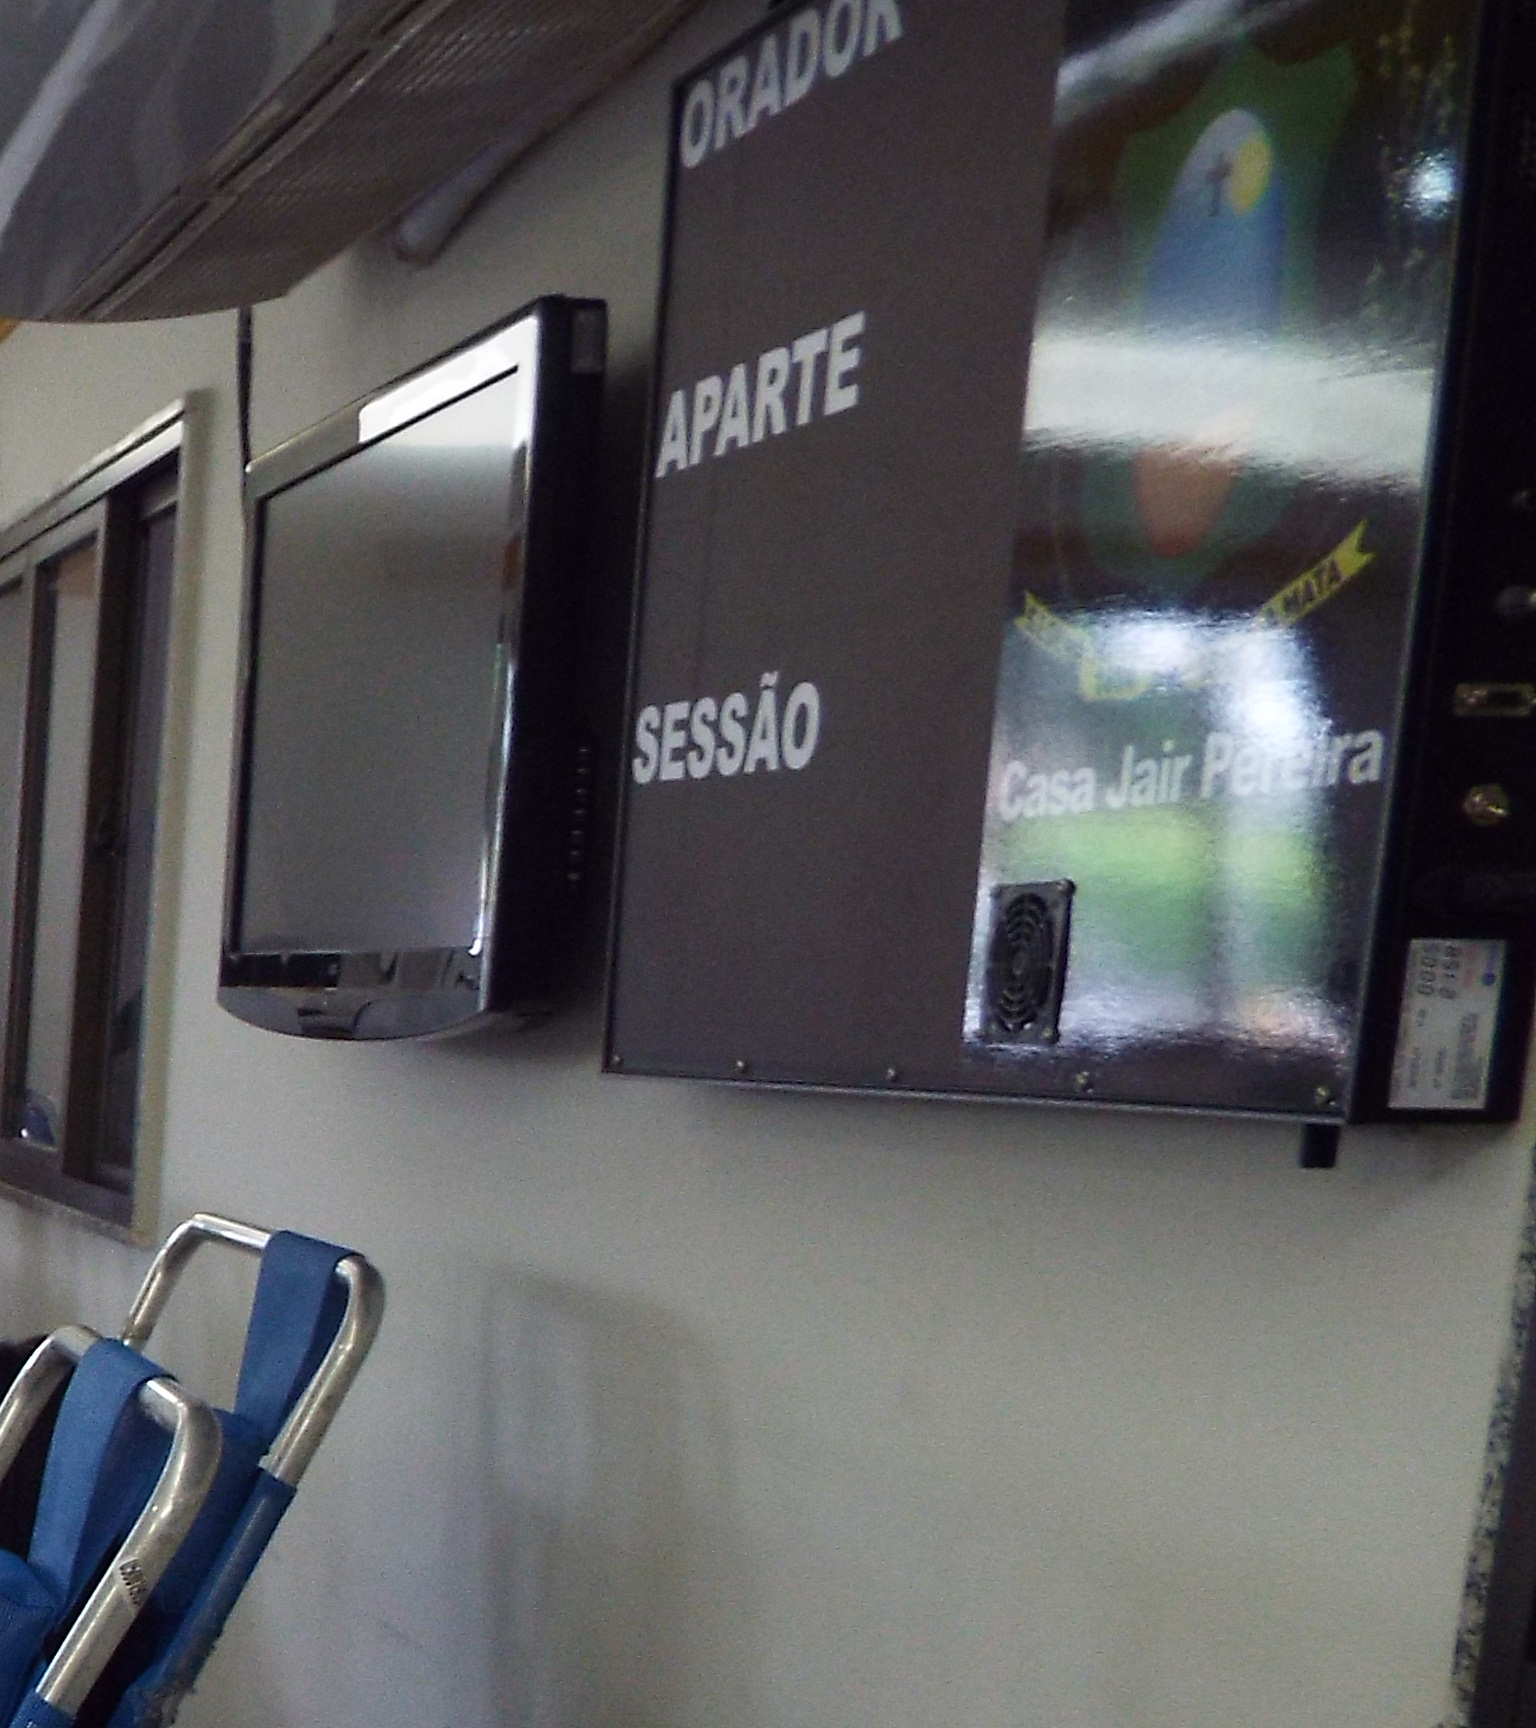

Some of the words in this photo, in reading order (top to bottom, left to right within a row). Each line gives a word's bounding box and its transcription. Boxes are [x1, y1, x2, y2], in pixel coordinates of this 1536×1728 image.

[655, 310, 866, 478] APARTE
[632, 670, 821, 784] SESSÃO
[998, 759, 1097, 821] Casa
[1105, 738, 1193, 809] Jair
[1200, 729, 1385, 799] Pereira
